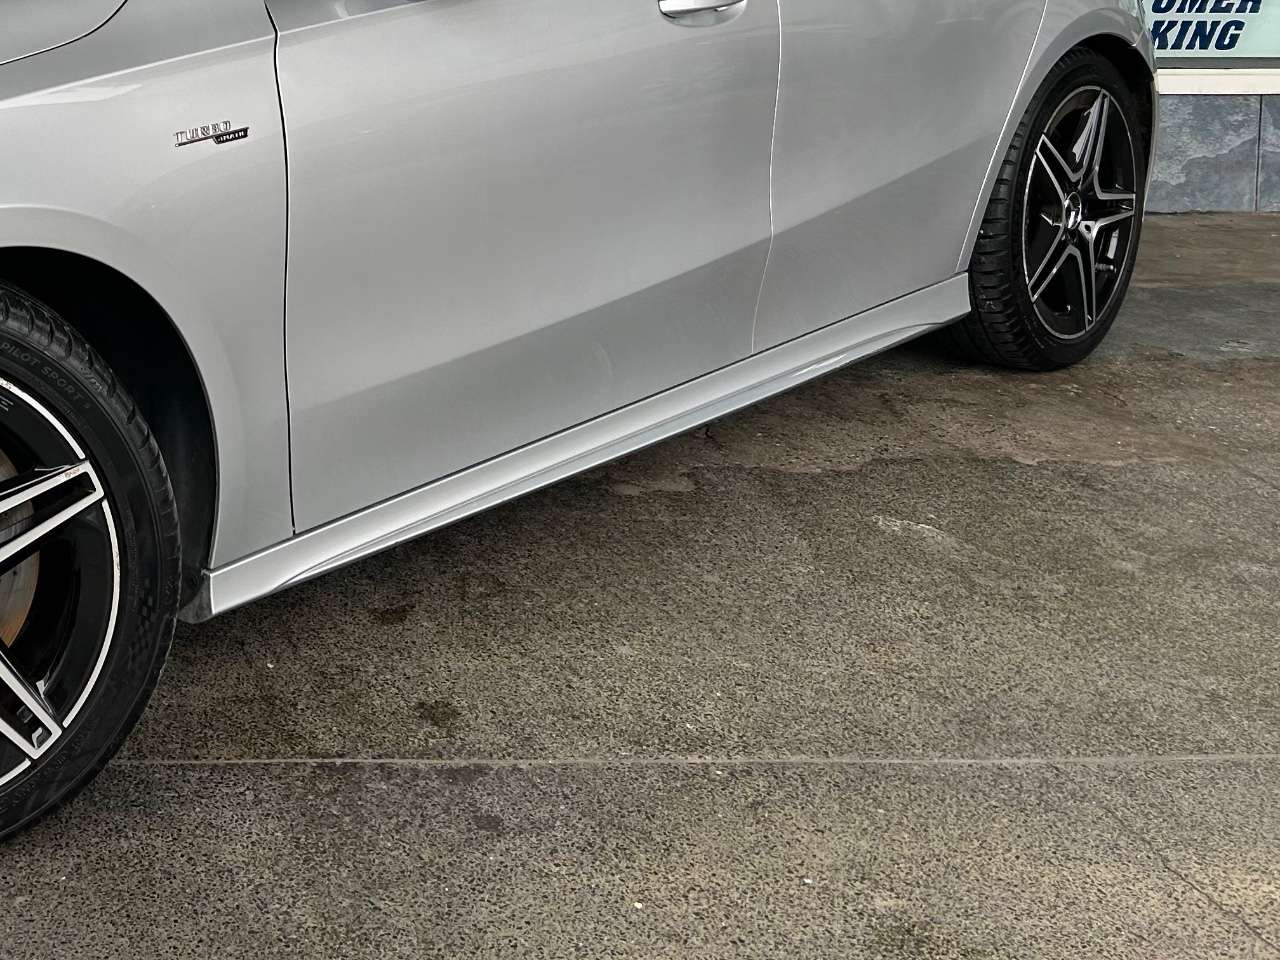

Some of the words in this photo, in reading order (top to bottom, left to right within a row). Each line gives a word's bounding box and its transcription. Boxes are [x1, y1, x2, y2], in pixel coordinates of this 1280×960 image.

[1151, 19, 1246, 51] KING
[0, 342, 41, 366] PILOT
[41, 366, 87, 401] SPORT
